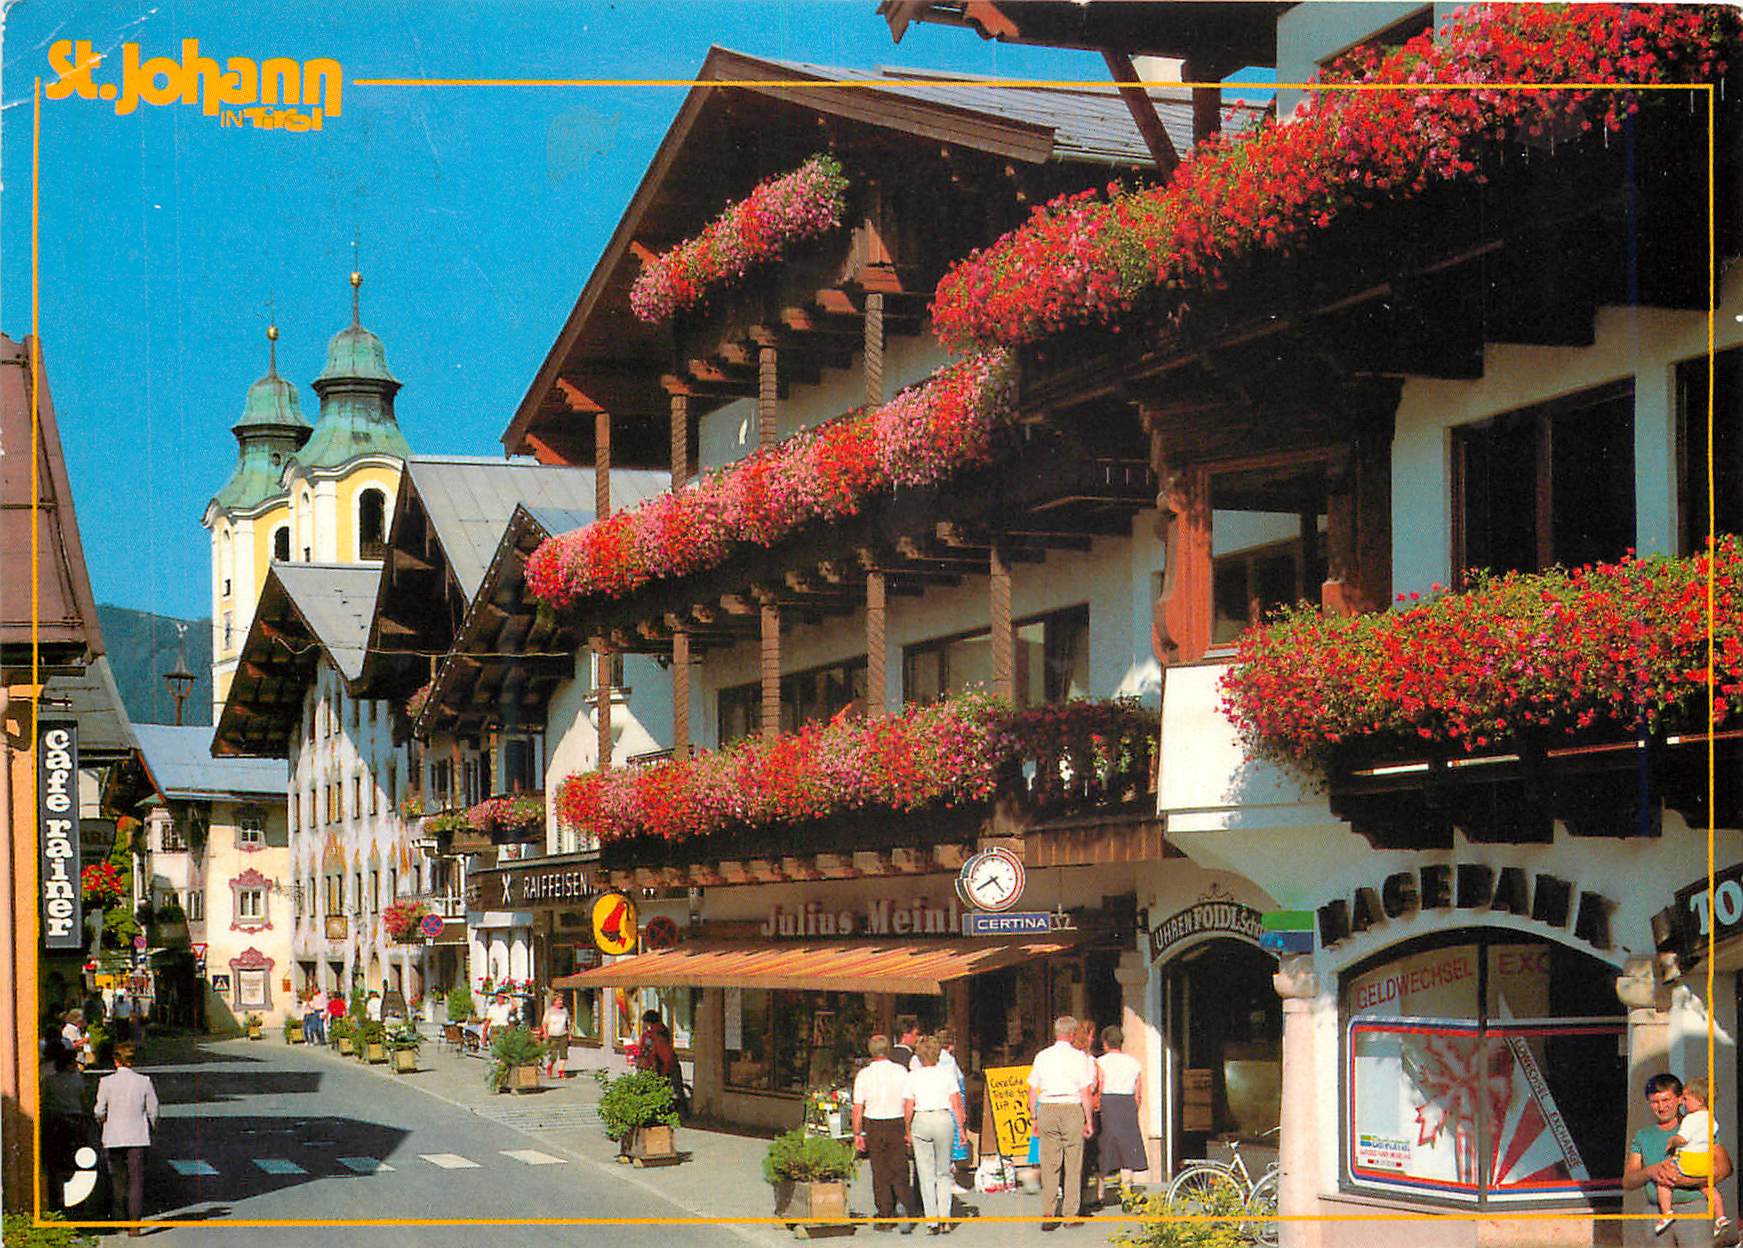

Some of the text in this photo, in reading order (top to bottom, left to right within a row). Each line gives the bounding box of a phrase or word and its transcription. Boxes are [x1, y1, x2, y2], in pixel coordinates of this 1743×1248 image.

[45, 819, 75, 937] rainer
[522, 871, 597, 900] RAIFFEISEN
[760, 896, 961, 937] Julius Meinl
[976, 917, 1048, 931] CERTINA
[1689, 876, 1743, 936] TO
[1154, 917, 1194, 950] UHREN
[1355, 956, 1474, 1009] GELDWECHSEL
[1499, 951, 1550, 975] EXC
[1550, 1110, 1585, 1169] EXCHANGE
